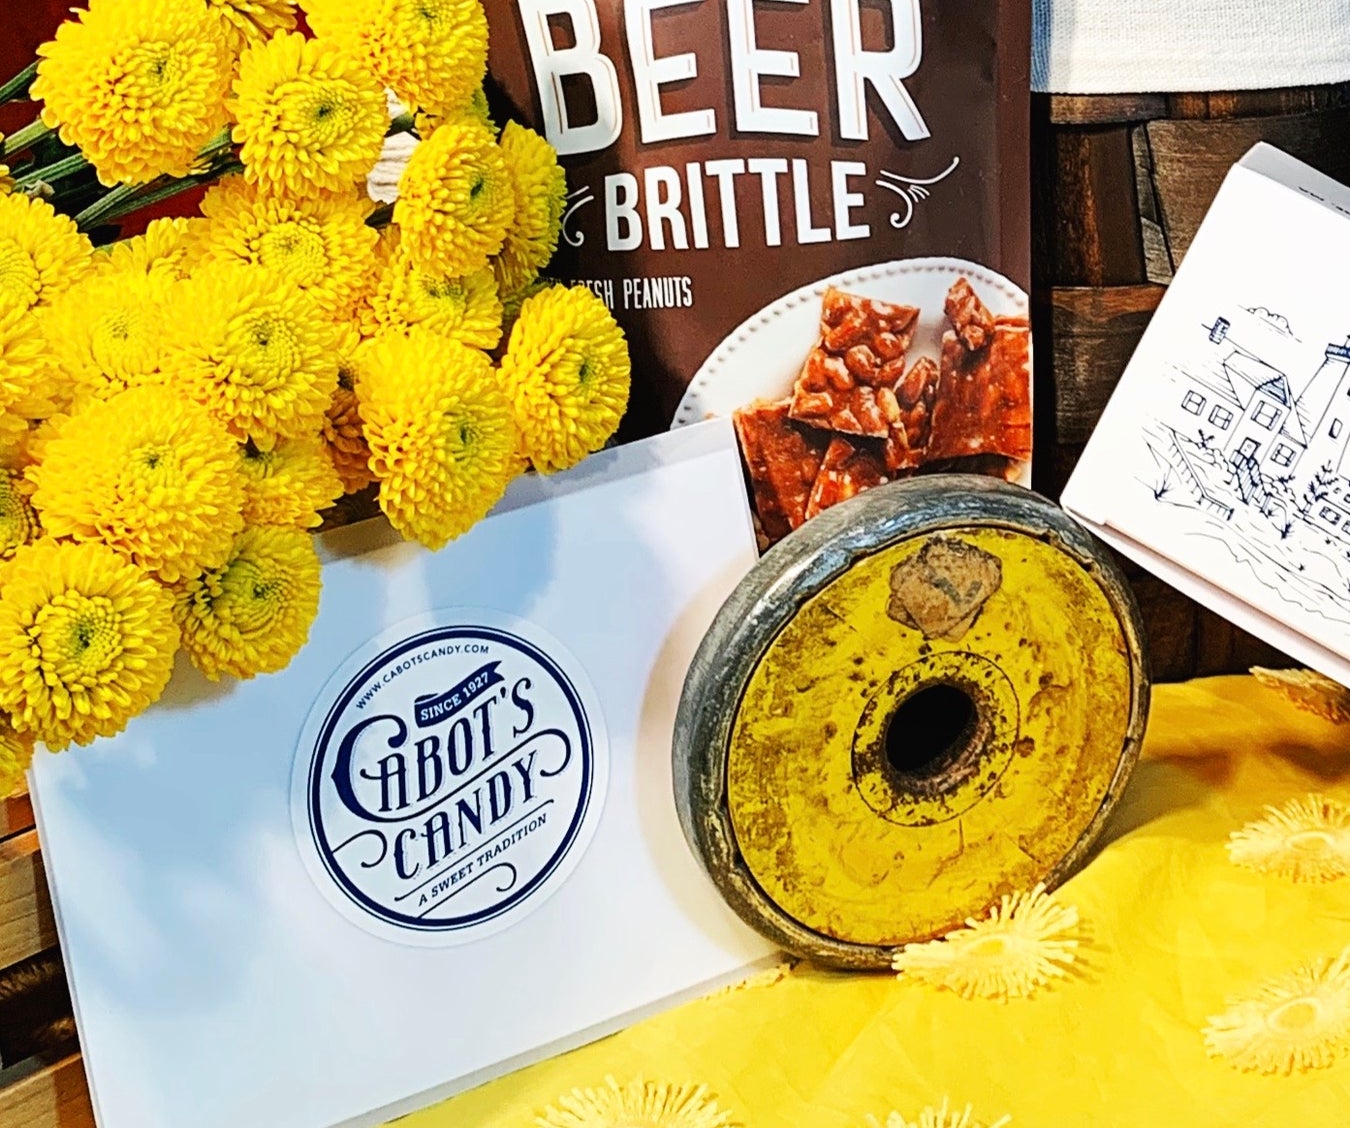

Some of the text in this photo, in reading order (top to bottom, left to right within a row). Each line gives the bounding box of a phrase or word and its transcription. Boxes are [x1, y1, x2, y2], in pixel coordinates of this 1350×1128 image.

[604, 158, 872, 253] BRITTLE
[623, 276, 693, 310] PEANUTS
[355, 643, 490, 710] WWW.CABOTSCANDY.COM
[420, 671, 490, 722] SINCE 1927
[331, 677, 535, 823] CABOT'S
[393, 749, 539, 880] CANDY
[418, 813, 548, 907] A SWEET TRADITION
